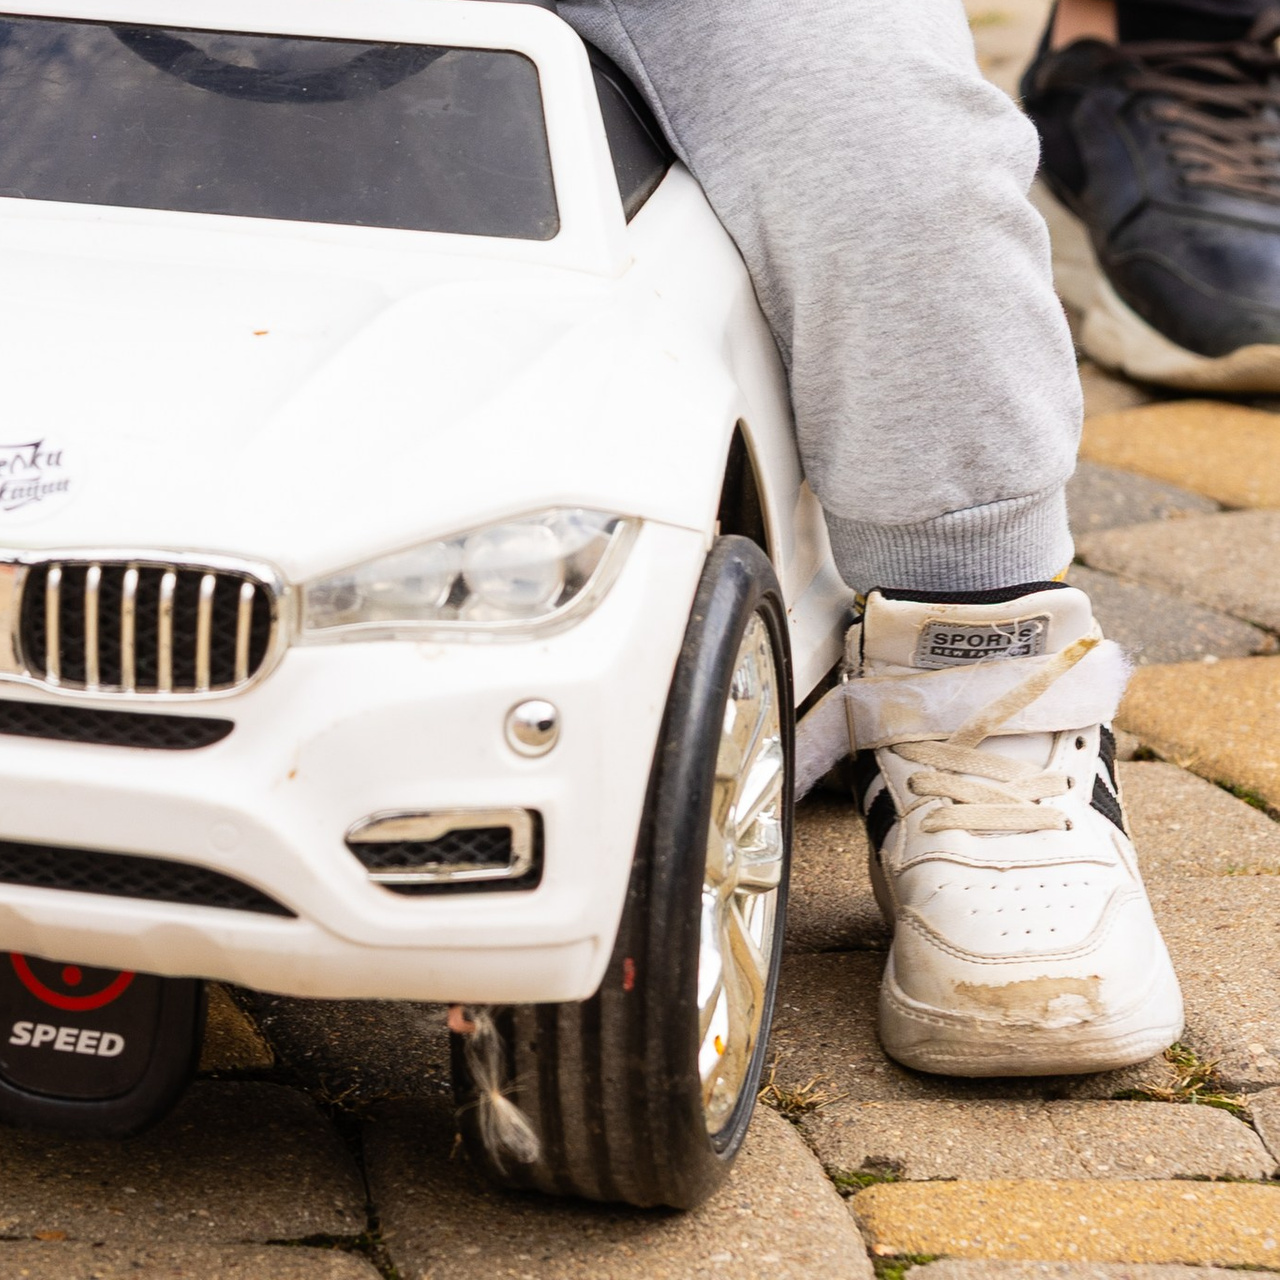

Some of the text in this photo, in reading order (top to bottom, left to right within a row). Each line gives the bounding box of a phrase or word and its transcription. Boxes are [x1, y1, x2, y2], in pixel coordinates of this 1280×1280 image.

[933, 628, 1032, 648] SPORTS
[933, 648, 964, 657] NEW
[9, 1021, 125, 1058] SPEED
